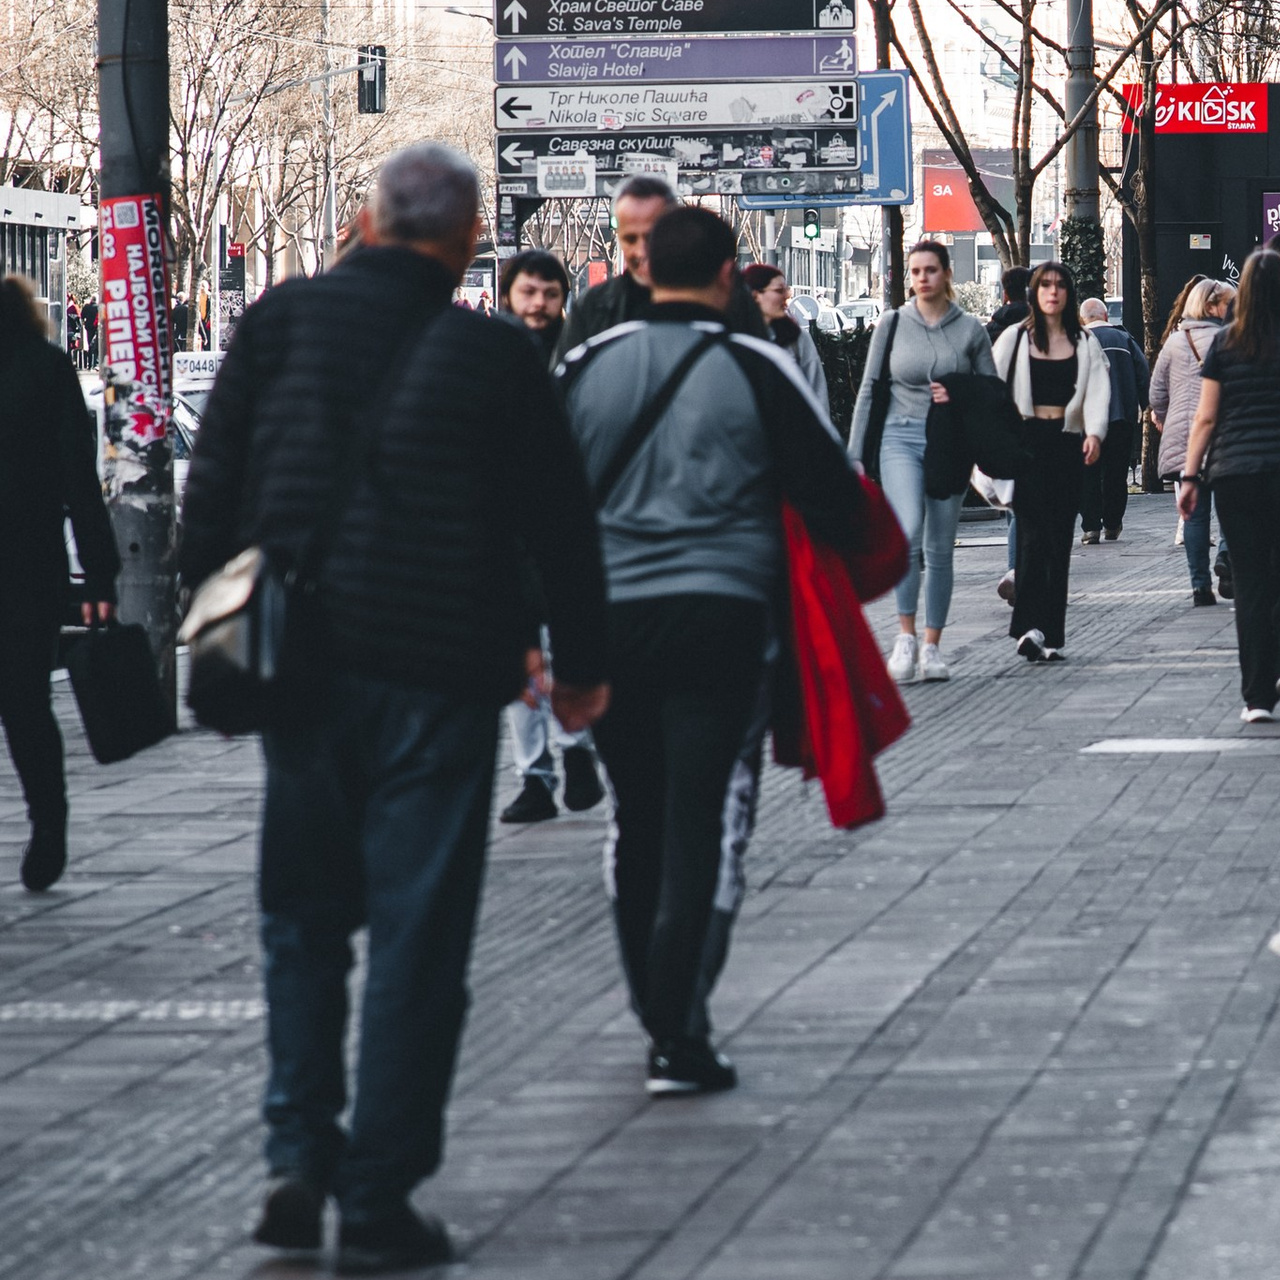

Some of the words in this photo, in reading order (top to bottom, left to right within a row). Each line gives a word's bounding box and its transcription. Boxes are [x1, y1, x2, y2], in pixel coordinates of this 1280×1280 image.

[547, 0, 592, 16] Храм
[547, 17, 567, 32] St.
[573, 16, 624, 31] Sava's
[628, 16, 683, 33] Temple
[547, 63, 598, 80] Slavija
[602, 62, 644, 77] Hotel
[548, 91, 575, 107] Трг
[578, 91, 640, 105] Николе
[643, 88, 708, 104] Пашића
[548, 110, 597, 124] Nikola
[604, 108, 646, 123] sic
[1227, 122, 1256, 130] ŠTAMPA
[549, 136, 615, 151] Савезна
[126, 243, 154, 343] НАЈБОЉИ
[105, 278, 137, 385] РЕПЕР
[189, 359, 215, 373] 0448
